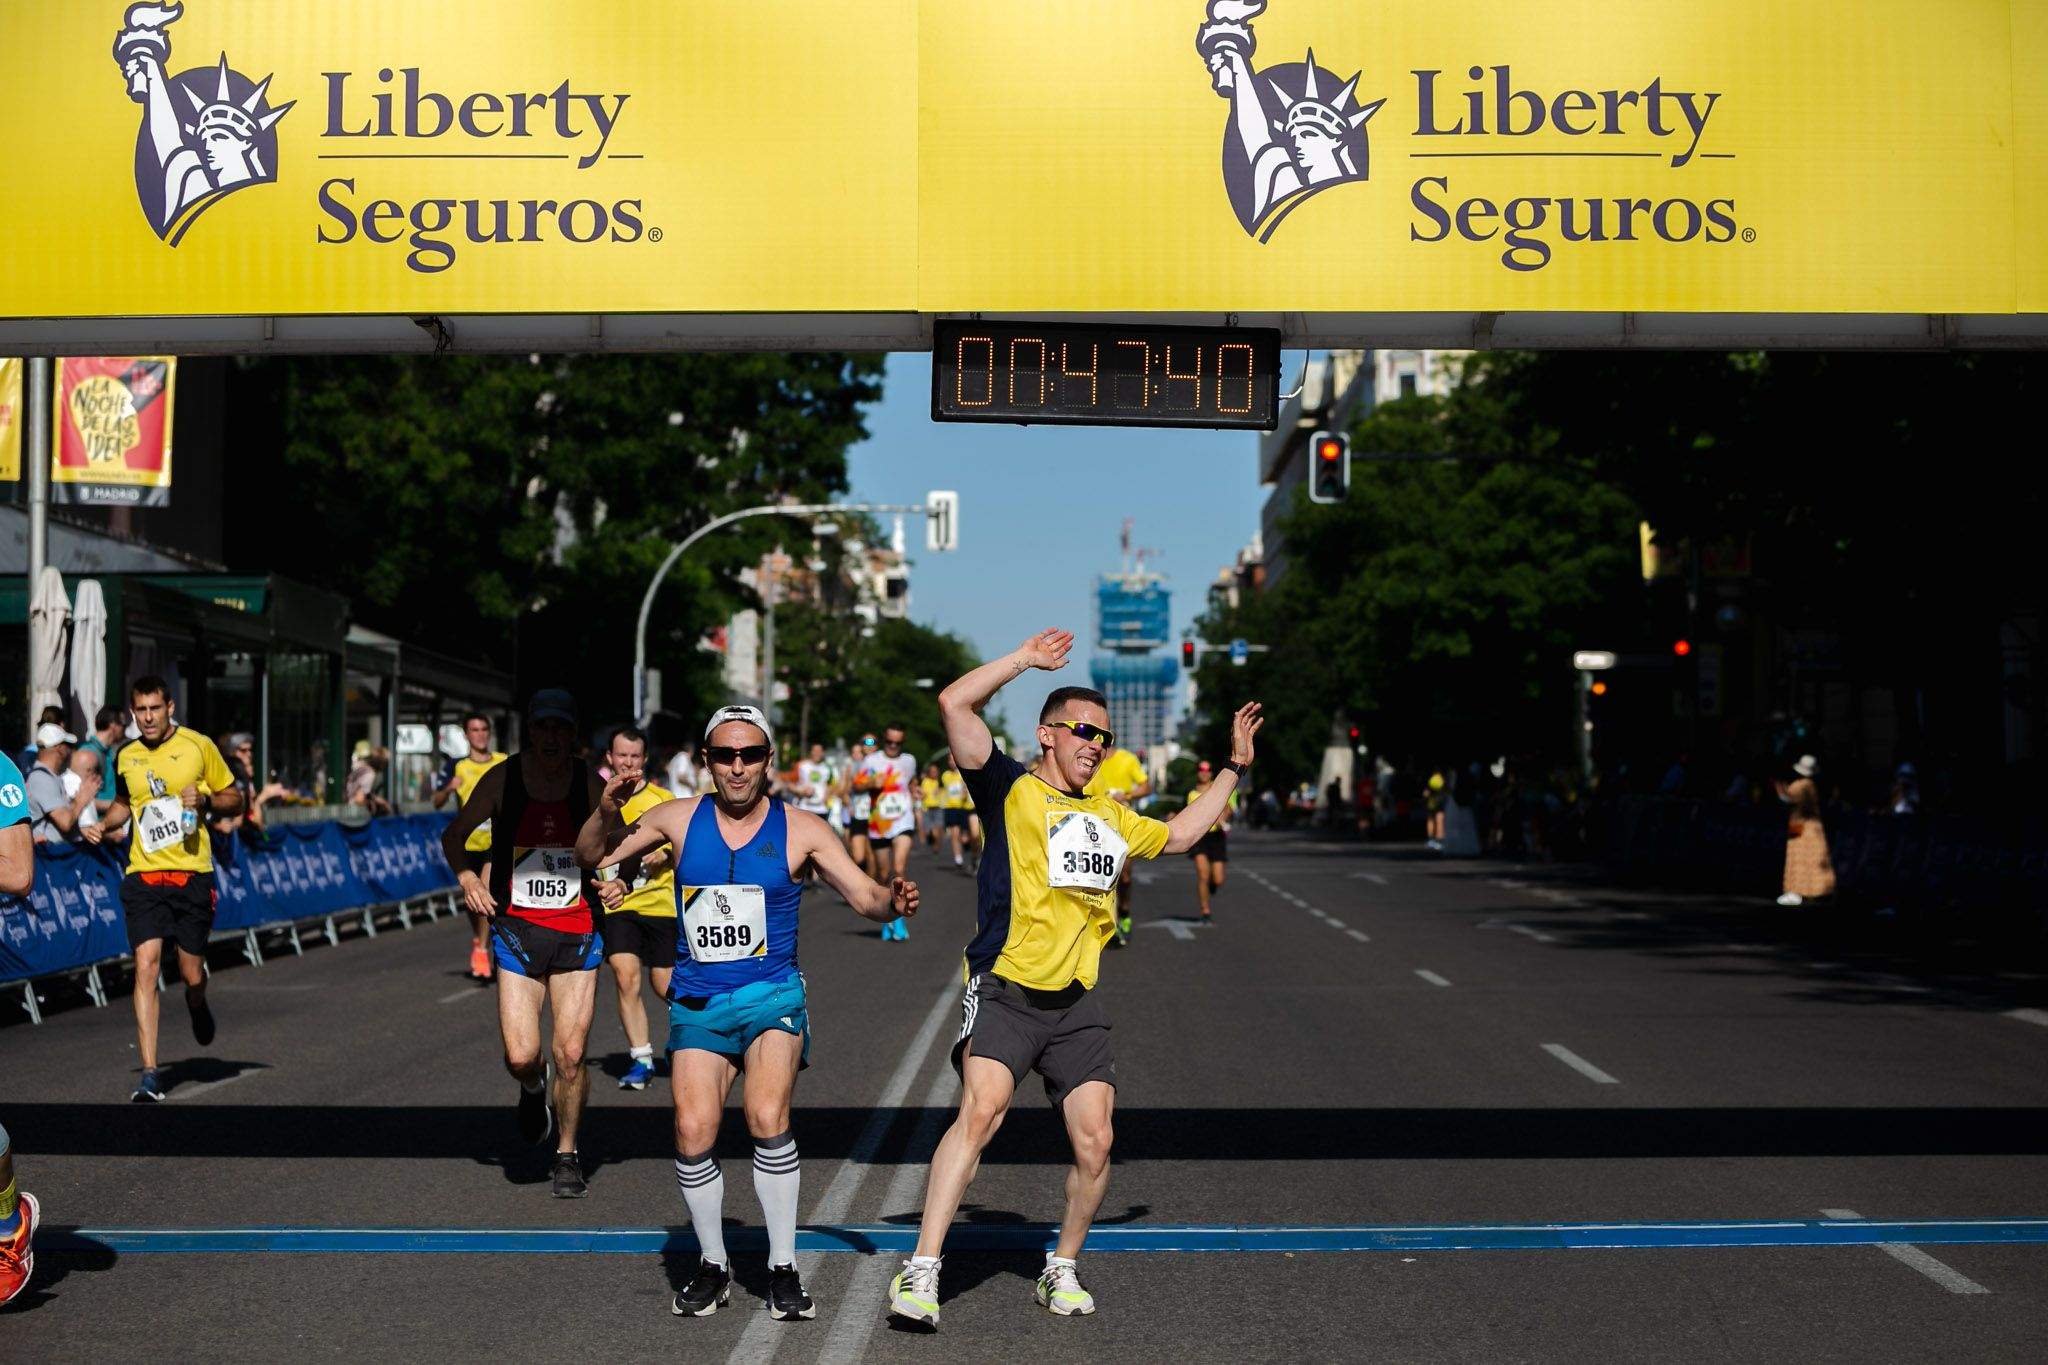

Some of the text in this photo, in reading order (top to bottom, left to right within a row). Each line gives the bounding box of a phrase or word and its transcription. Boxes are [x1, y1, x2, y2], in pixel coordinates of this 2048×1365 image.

[320, 67, 631, 169] Liberty
[1410, 64, 1722, 168] Liberty
[92, 378, 110, 393] LA
[957, 337, 1253, 413] 00:47:40
[149, 820, 179, 842] 2813
[1063, 851, 1114, 877] 3588
[526, 879, 567, 897] 1053
[697, 924, 751, 948] 3589
